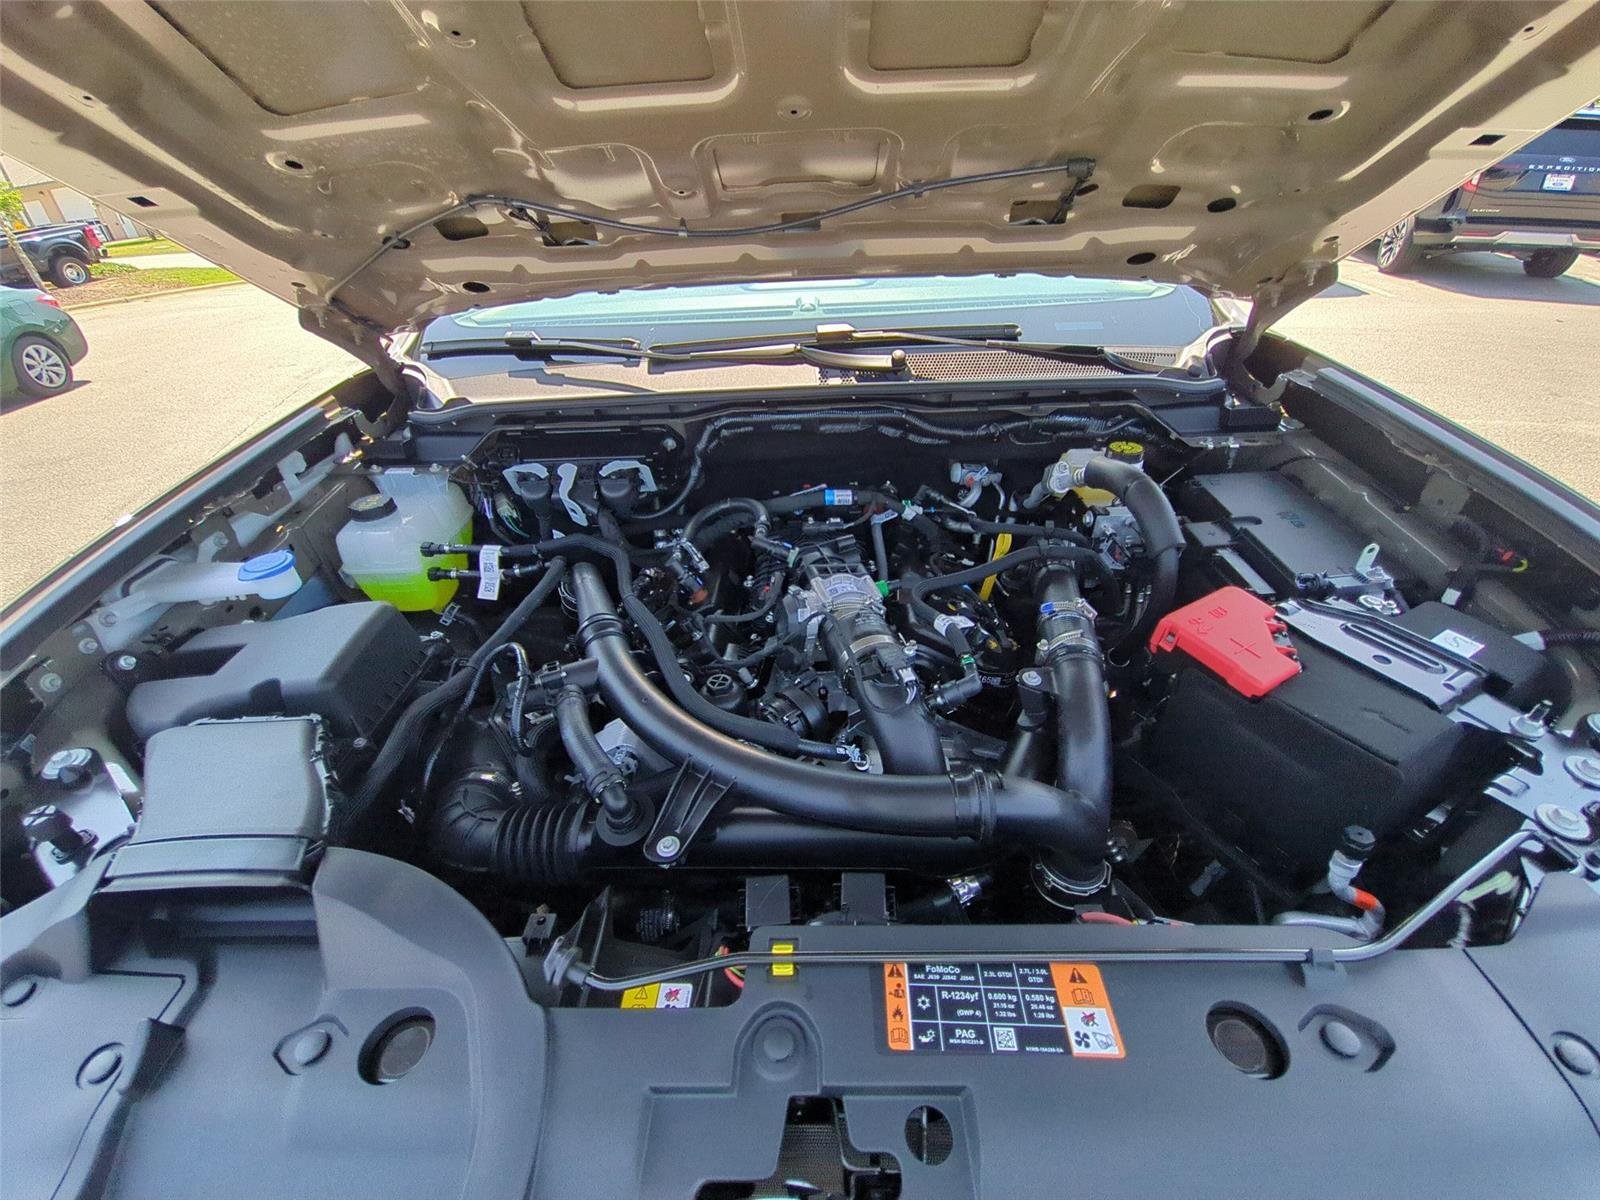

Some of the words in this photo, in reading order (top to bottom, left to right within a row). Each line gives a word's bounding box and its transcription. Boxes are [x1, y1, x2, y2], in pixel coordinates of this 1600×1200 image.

[925, 965, 961, 974] FoMoCo
[941, 991, 979, 1003] R-1234yf
[1008, 993, 1018, 1003] kg
[1045, 994, 1055, 1003] kg
[956, 1009, 975, 1017] (GWP
[955, 1029, 976, 1039] PAG
